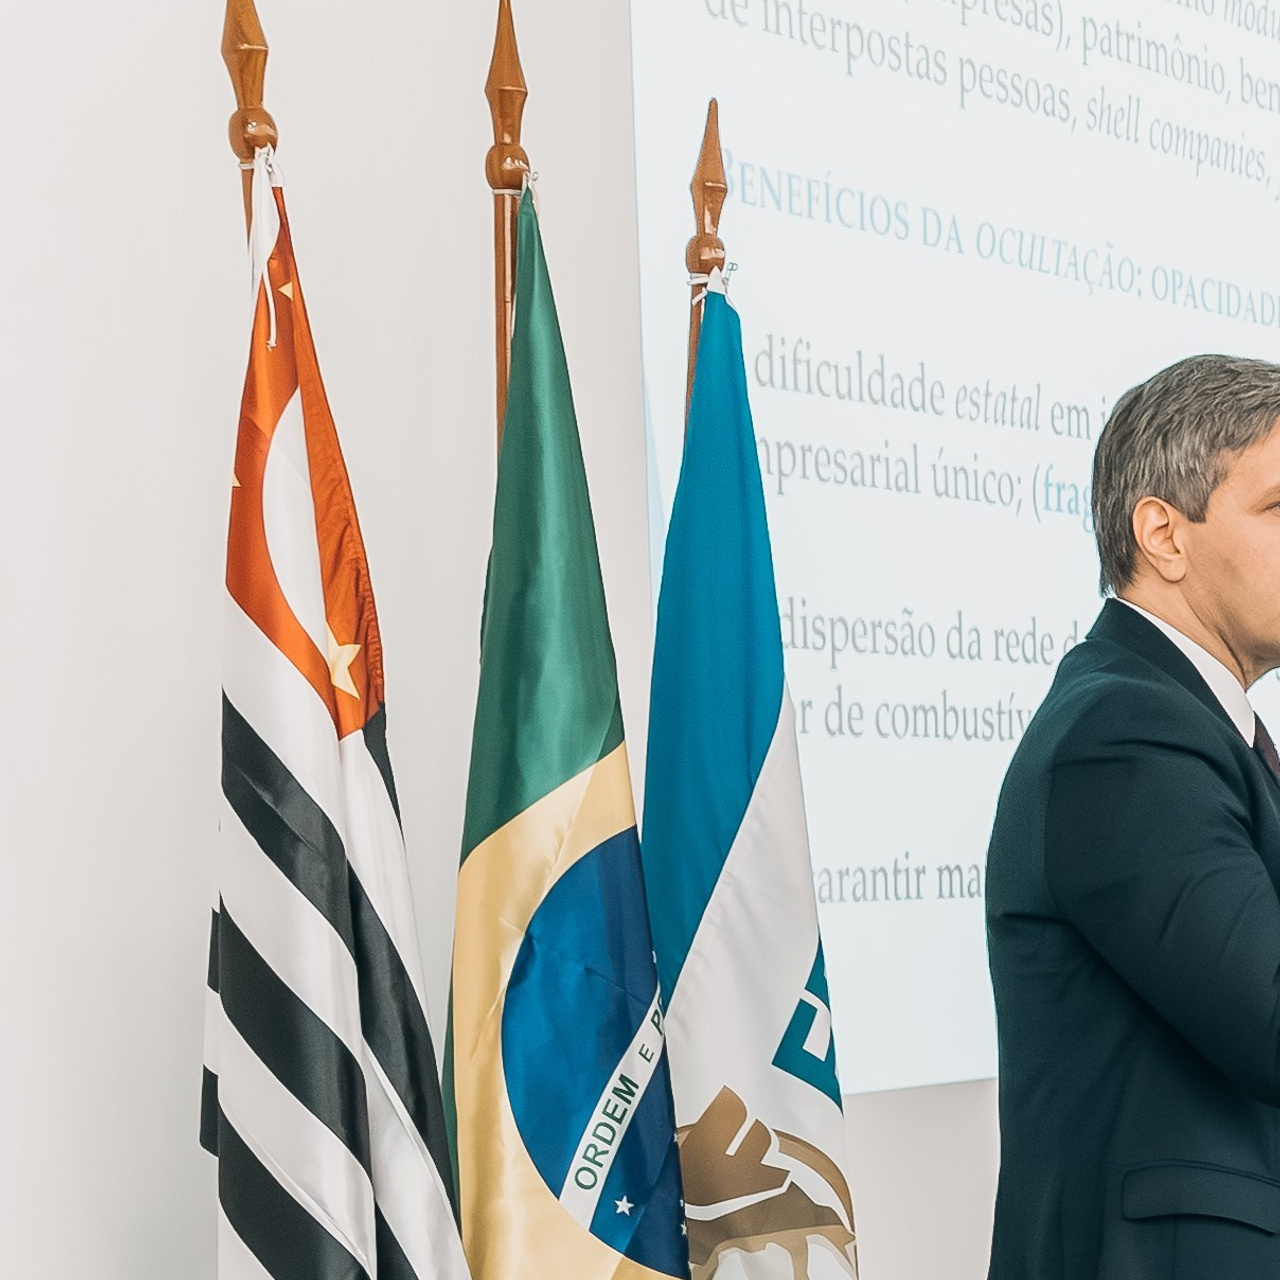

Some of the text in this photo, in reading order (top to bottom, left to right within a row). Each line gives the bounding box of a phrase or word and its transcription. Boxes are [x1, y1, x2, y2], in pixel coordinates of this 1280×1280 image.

[762, 0, 947, 85] interpostas
[959, 57, 1076, 133] pessoas,
[1087, 85, 1140, 143] shell
[1149, 118, 1271, 190] companies,
[1082, 15, 1231, 105] patrimônio,
[922, 206, 965, 254] DA
[976, 221, 1142, 297] OCULTAÇÃO:
[755, 333, 945, 416] dificuldade
[955, 379, 1041, 432] estatal
[1051, 401, 1092, 441] em
[931, 447, 1022, 517] único;
[946, 610, 983, 660] da
[993, 616, 1054, 666] rede
[825, 684, 863, 738] de
[813, 851, 927, 904] arantir
[575, 1073, 640, 1190] ORDEM
[638, 1043, 655, 1063] E
